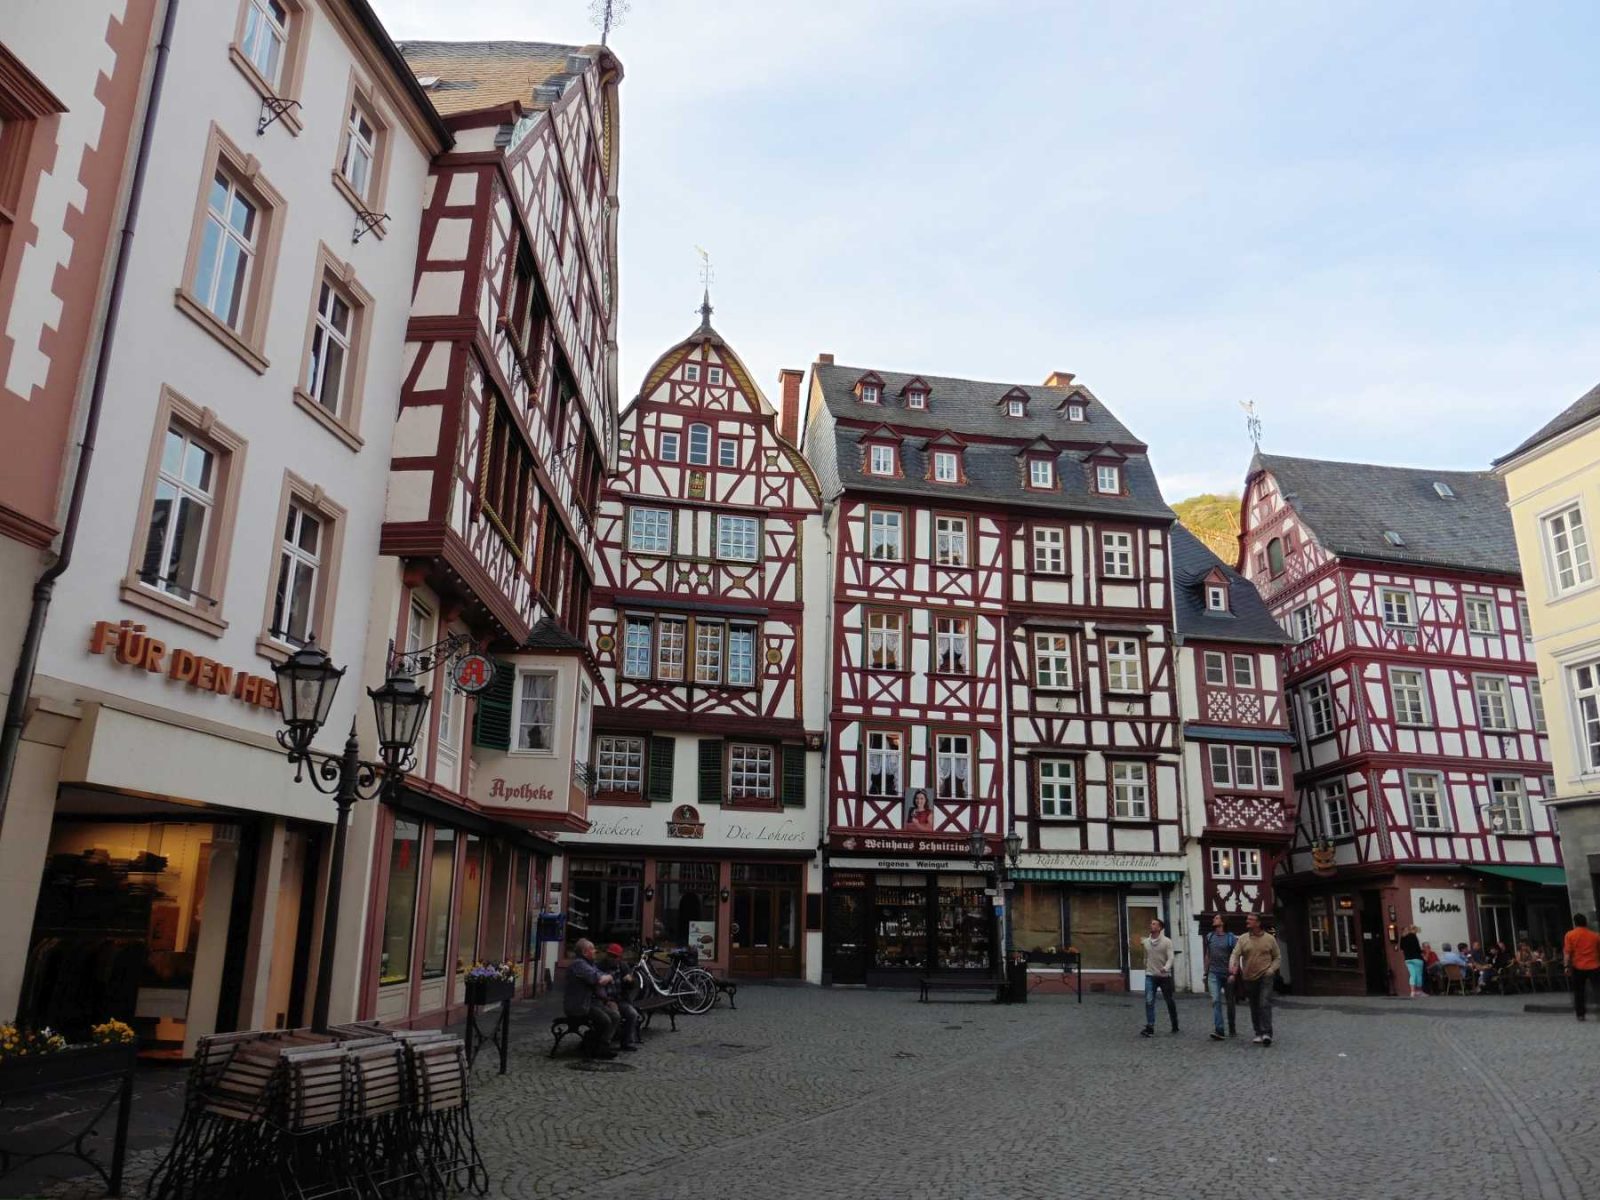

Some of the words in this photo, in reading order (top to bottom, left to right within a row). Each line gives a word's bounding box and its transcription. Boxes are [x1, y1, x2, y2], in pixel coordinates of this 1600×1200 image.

[88, 619, 166, 673] FÜR
[170, 648, 233, 695] DEN
[458, 657, 485, 687] A
[489, 777, 553, 802] Apotheke
[726, 823, 752, 840] Die
[757, 819, 807, 842] Lohners
[864, 838, 915, 854] Weinhaus
[878, 861, 909, 869] eigenes
[916, 860, 949, 869] Weingut
